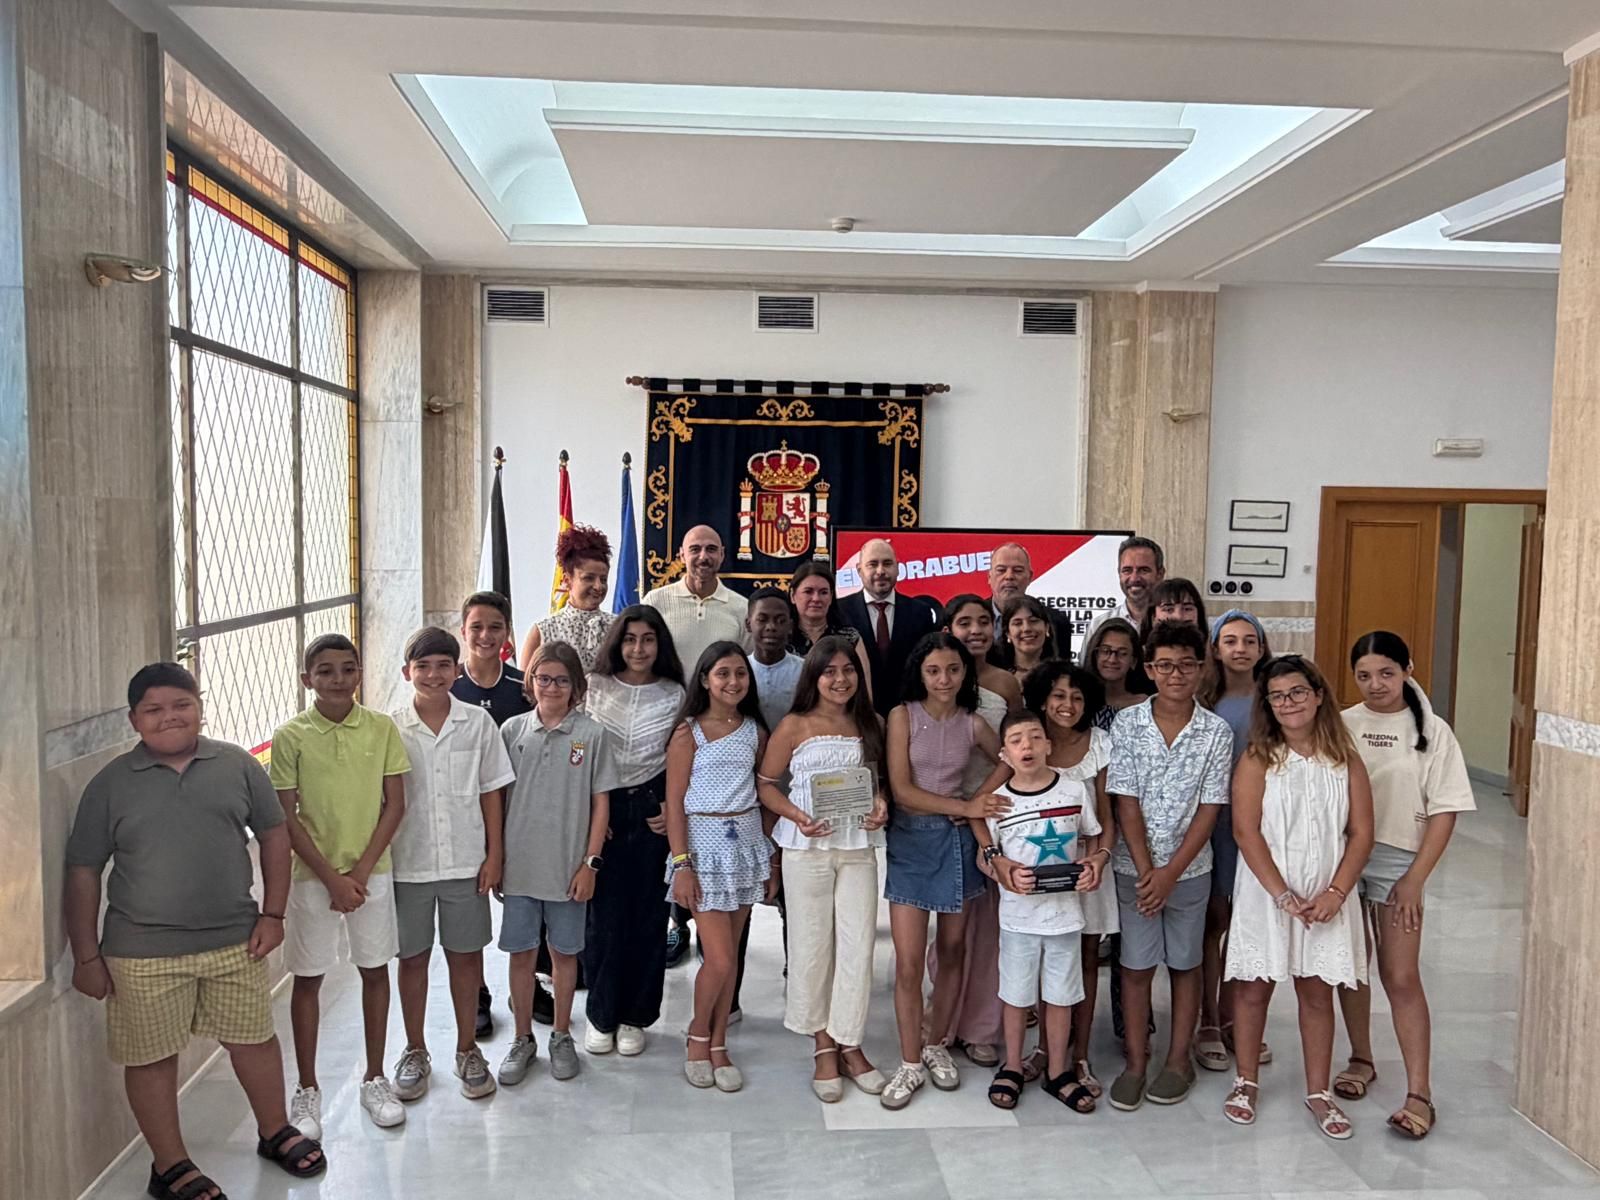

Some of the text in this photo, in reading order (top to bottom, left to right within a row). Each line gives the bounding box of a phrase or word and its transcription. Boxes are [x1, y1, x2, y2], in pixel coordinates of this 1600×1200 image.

[1037, 597, 1117, 608] SECRETOS
[1075, 610, 1093, 621] LA
[1362, 733, 1399, 741] ARIZONA
[1367, 740, 1394, 748] TIGERS
